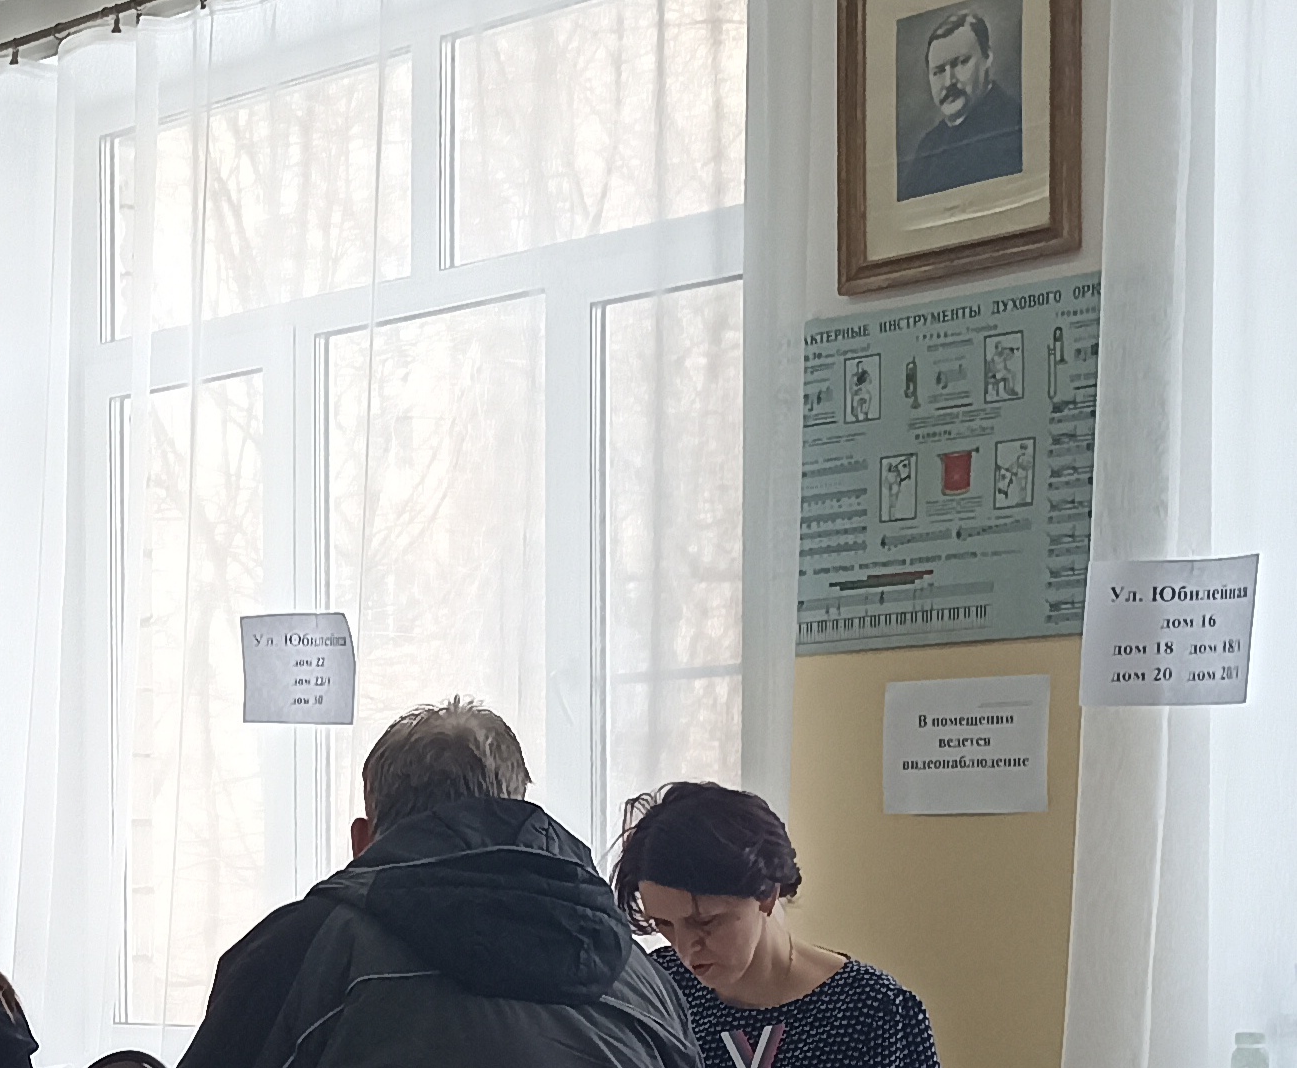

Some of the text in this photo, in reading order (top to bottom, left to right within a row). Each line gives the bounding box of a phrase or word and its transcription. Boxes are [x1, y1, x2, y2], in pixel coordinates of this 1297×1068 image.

[878, 304, 981, 334] ИНСТРУМЕНТЫ
[991, 290, 1062, 315] ДУХОВОГО
[1110, 584, 1248, 603] Ул. Юбилейная
[1161, 614, 1216, 630] дом 16
[1113, 645, 1147, 656] дом
[1155, 641, 1174, 654] 18
[1189, 644, 1217, 655] дом
[1111, 670, 1146, 683] дом
[1153, 667, 1173, 682] 20
[1187, 670, 1216, 682] дом
[918, 714, 1014, 728] В помещении
[938, 737, 991, 749] ведется
[902, 754, 1030, 771] видеонаблюдение
